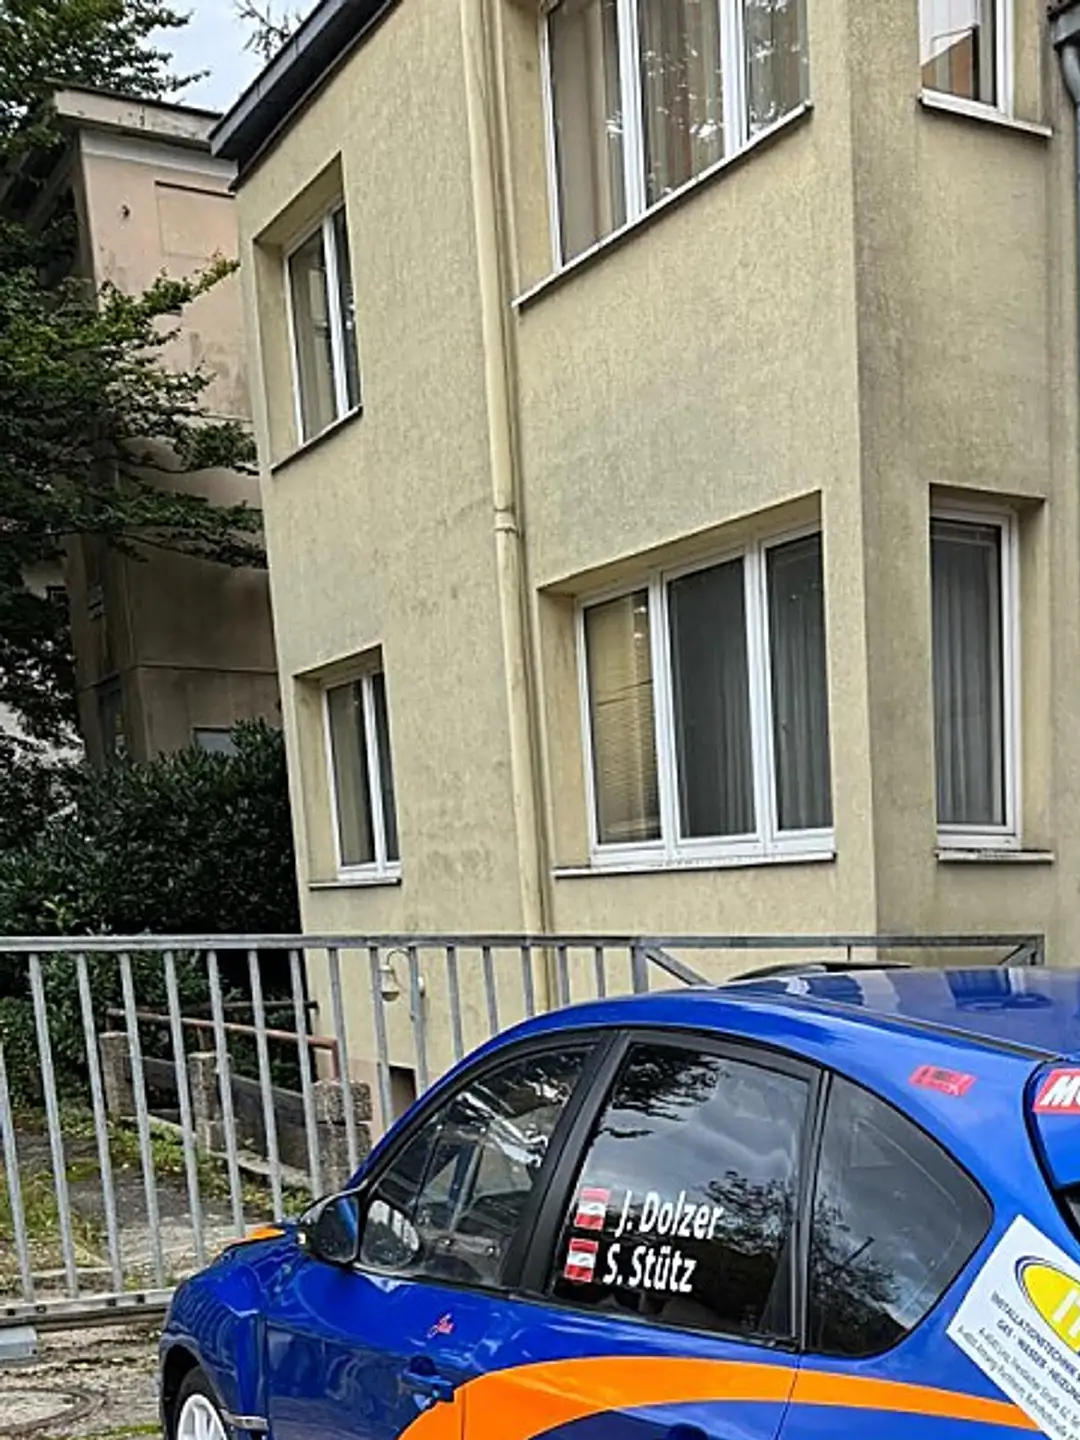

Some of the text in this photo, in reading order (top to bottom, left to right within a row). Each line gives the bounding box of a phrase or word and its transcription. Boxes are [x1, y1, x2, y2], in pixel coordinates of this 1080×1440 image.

[614, 1189, 724, 1240] J. Dolzer
[603, 1243, 697, 1293] S. Stütz
